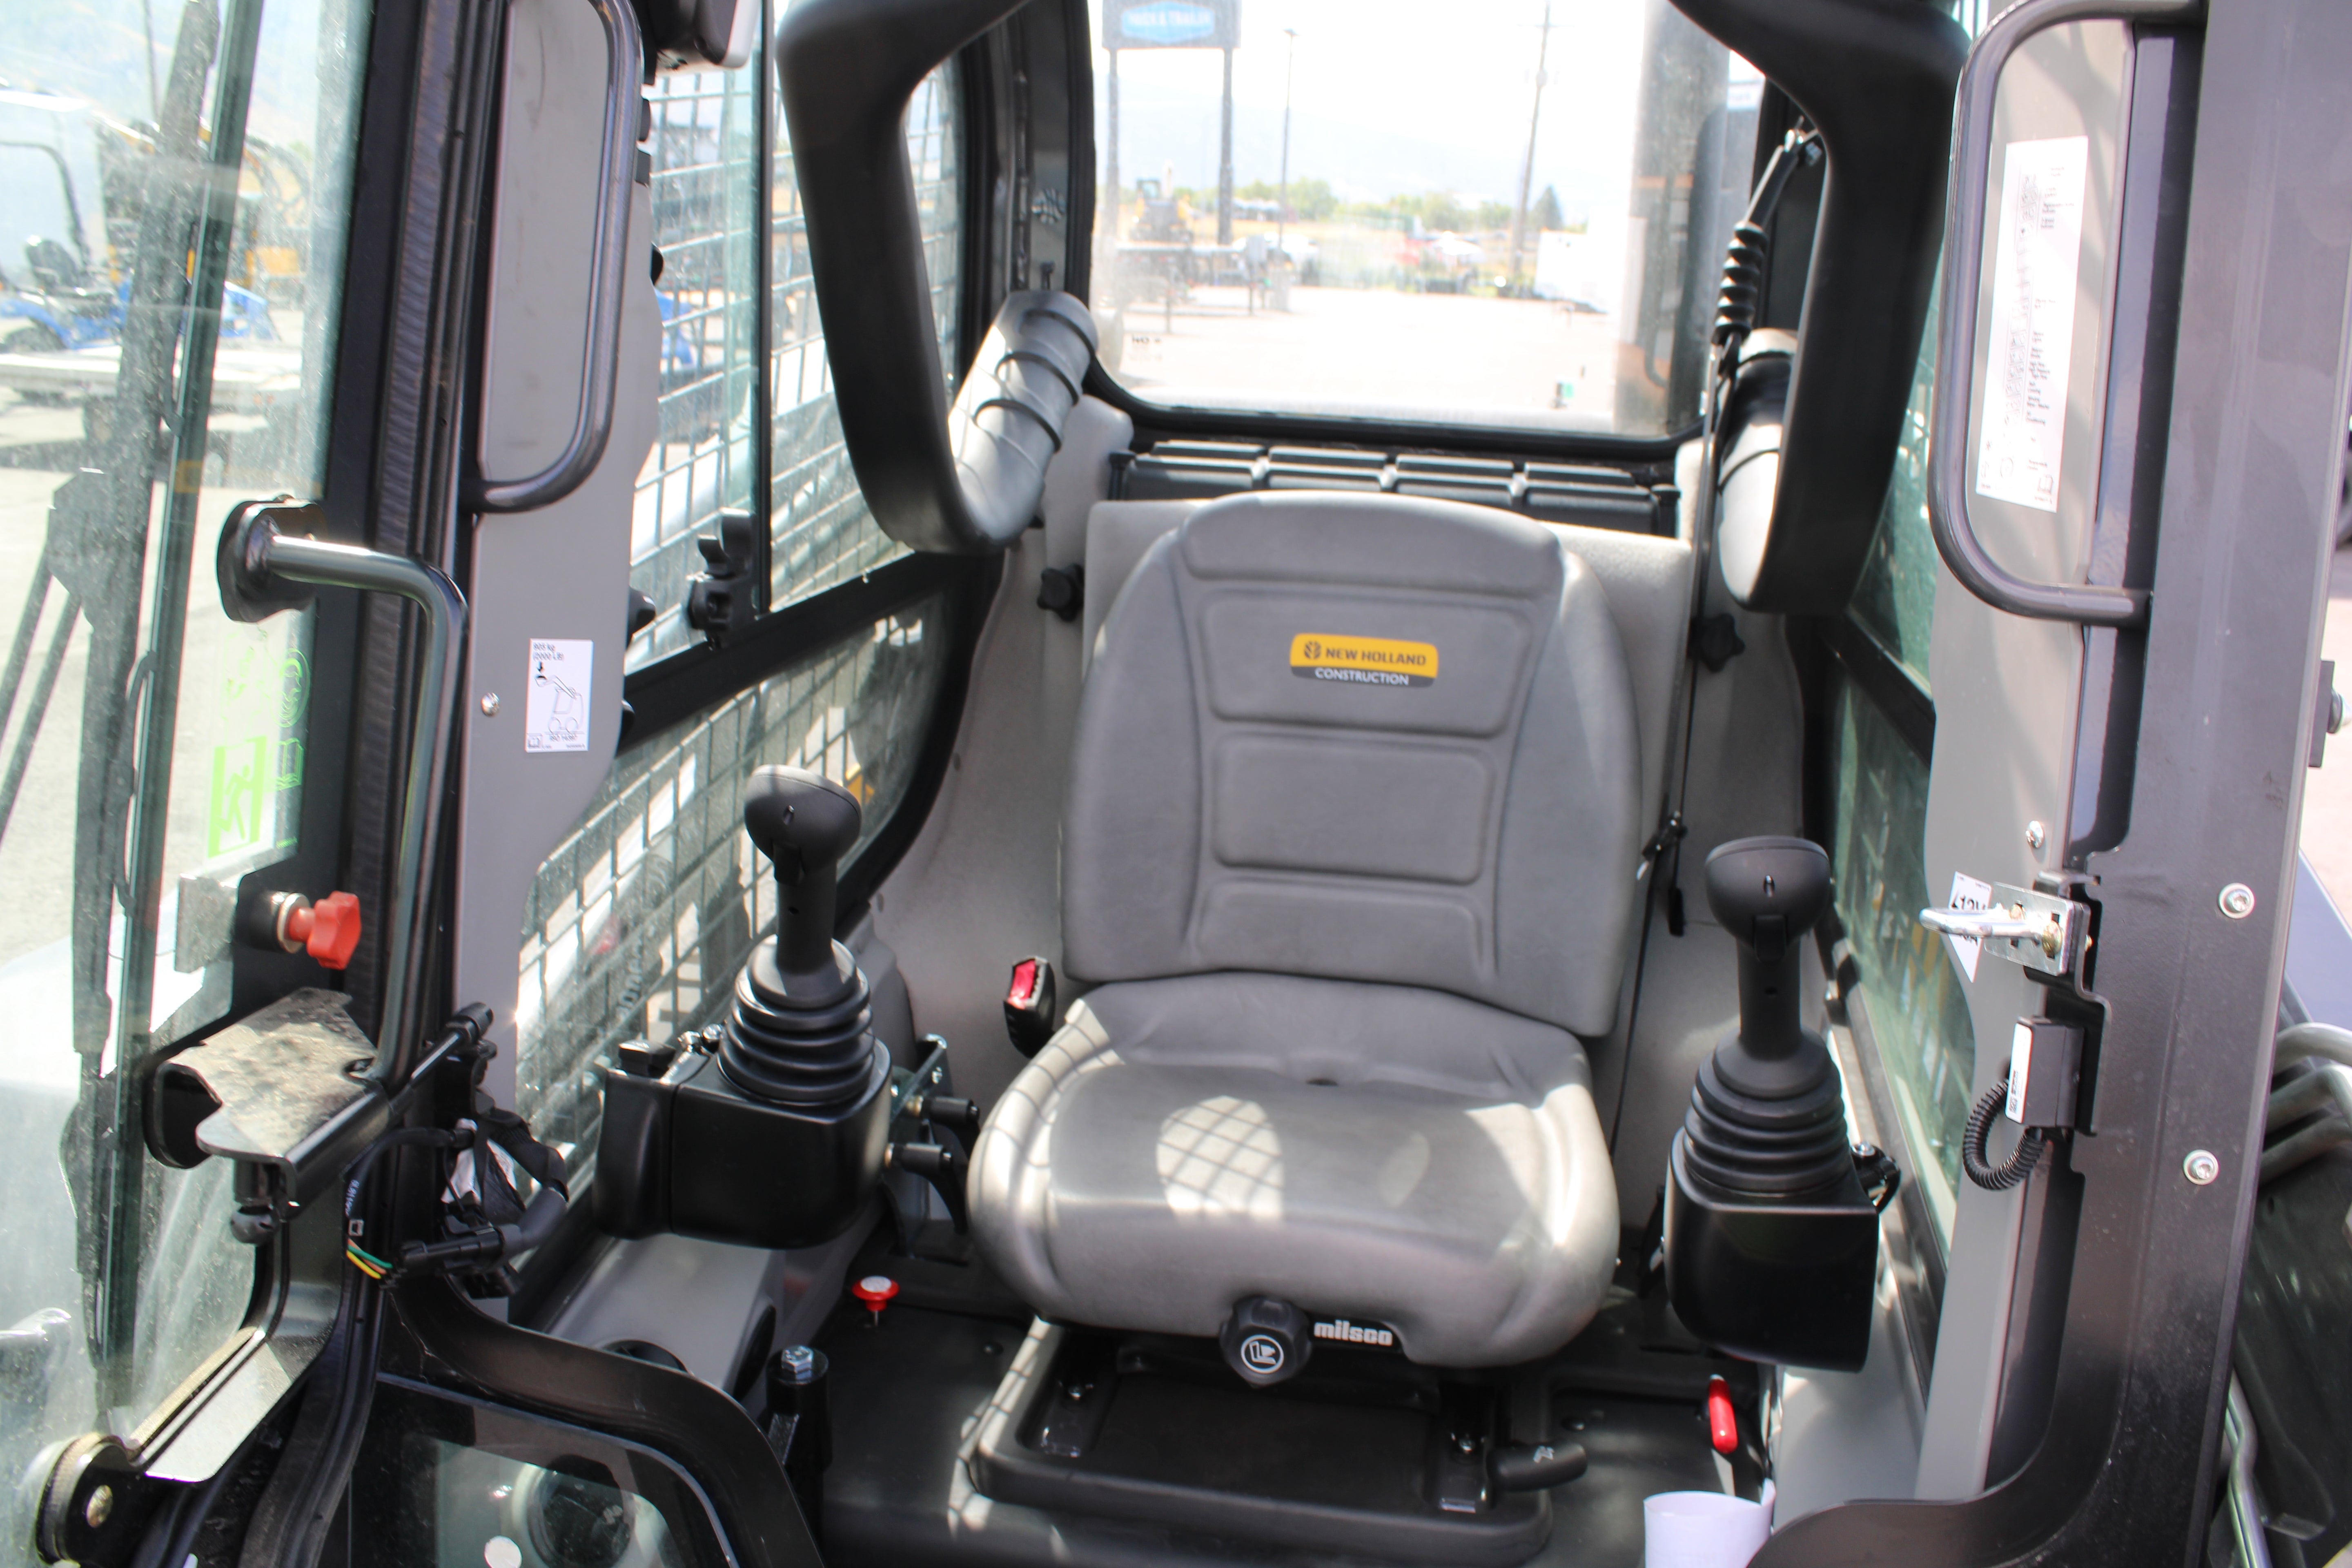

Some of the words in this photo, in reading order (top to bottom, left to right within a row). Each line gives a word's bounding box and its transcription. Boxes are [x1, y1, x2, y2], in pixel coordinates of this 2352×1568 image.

[1325, 647, 1357, 660] NEW
[1361, 650, 1427, 666] HOLLAND
[1314, 667, 1410, 686] CONSTRUCTION
[1314, 1319, 1393, 1346] milsco
